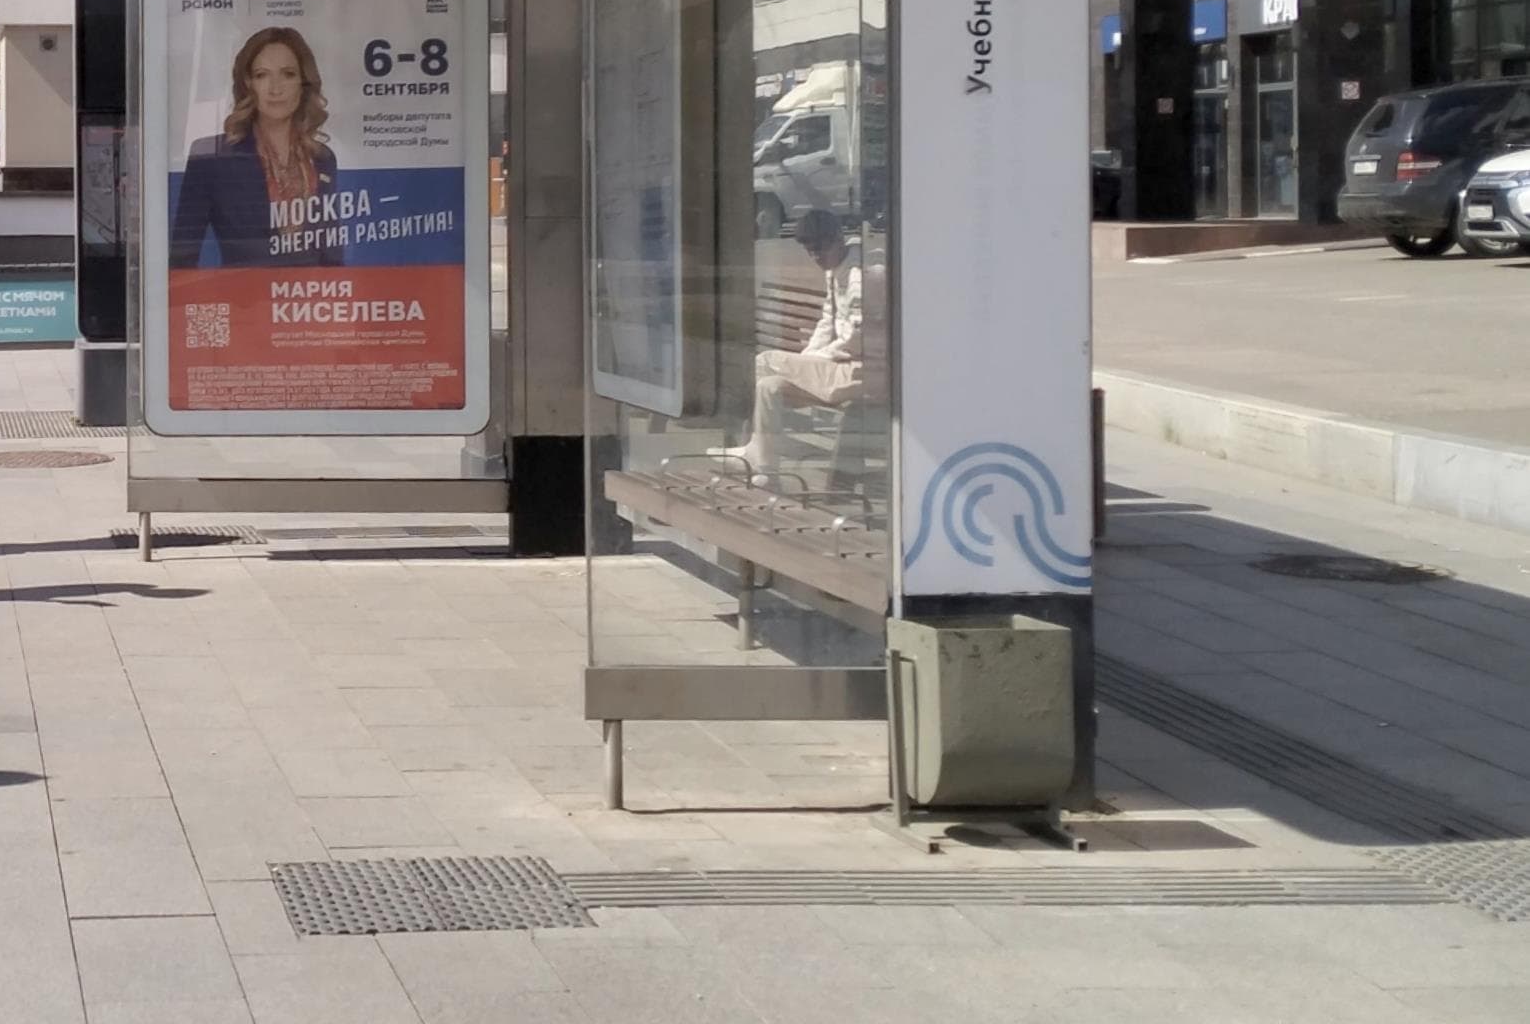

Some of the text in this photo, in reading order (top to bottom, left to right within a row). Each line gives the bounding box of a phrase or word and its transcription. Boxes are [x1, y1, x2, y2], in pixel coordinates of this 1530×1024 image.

[363, 82, 450, 96] СЕНТЯБРЯ
[270, 189, 371, 228] МОСКВА
[270, 210, 454, 256] ЭНЕРГИЯ РАЗВИТИЯ!
[271, 280, 354, 299] МАРИЯ
[272, 300, 426, 324] КИСЕЛЕВА
